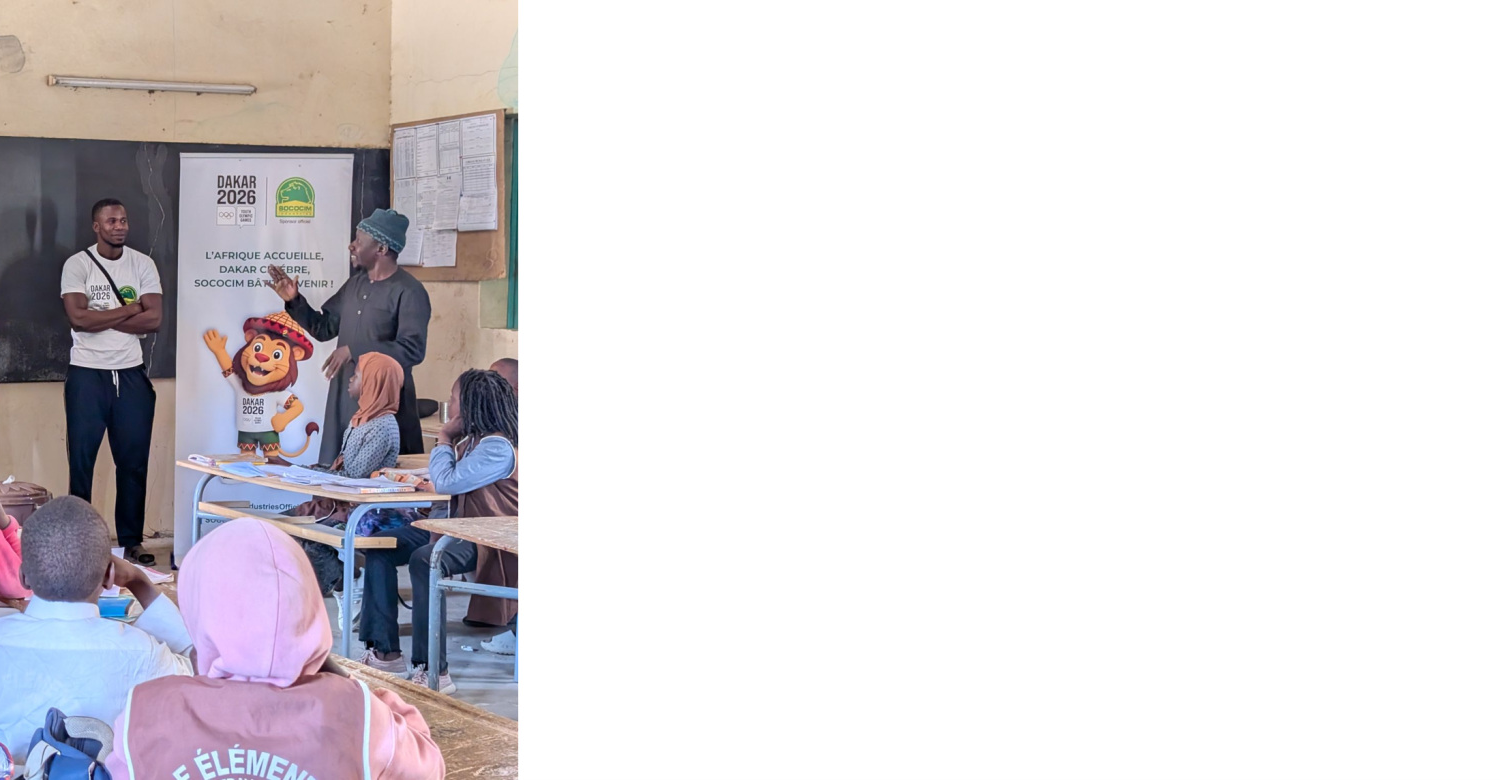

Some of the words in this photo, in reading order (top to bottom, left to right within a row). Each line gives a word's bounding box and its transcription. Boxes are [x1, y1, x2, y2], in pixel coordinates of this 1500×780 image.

[217, 175, 257, 189] DAKAR
[217, 189, 256, 205] 2026
[263, 252, 324, 261] ACCUEILLE,
[219, 265, 257, 274] DAKAR
[259, 264, 310, 275] CÉBRE,
[194, 279, 244, 288] SOCOCIM
[90, 284, 111, 293] DAKAR
[91, 292, 111, 300] 2026
[242, 397, 265, 406] DAKAR
[242, 405, 264, 415] 2026
[193, 743, 318, 780] ÉLÉMEN
